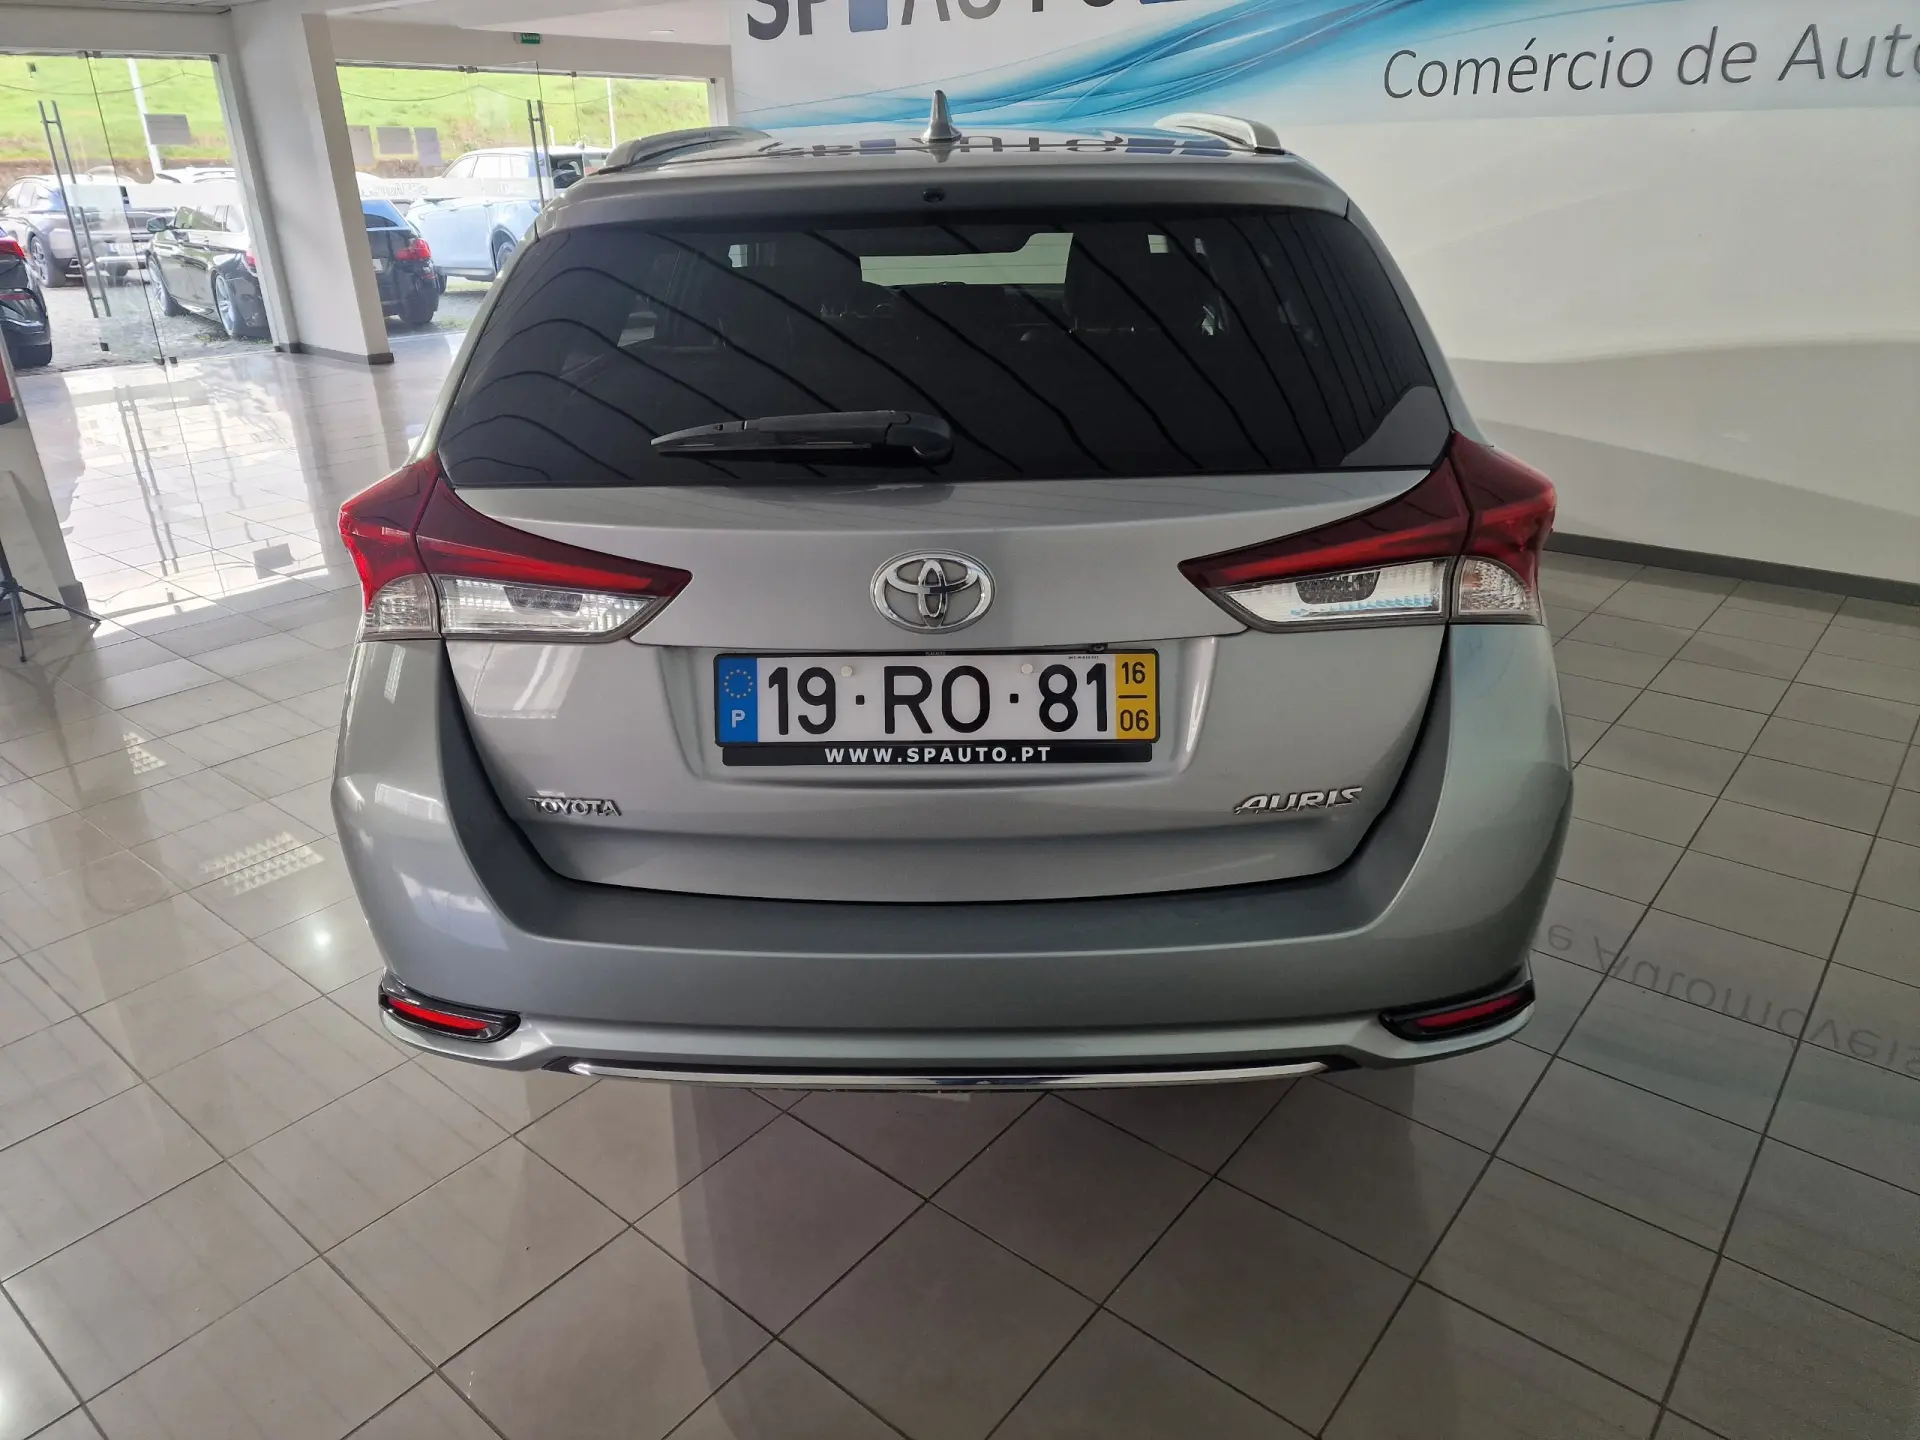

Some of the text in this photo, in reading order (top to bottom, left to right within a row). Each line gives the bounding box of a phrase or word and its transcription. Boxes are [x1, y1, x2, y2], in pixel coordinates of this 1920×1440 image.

[1383, 23, 1920, 99] Comércio de Aut
[1121, 661, 1146, 685] 16
[731, 710, 745, 728] P
[1120, 709, 1149, 732] 06
[824, 747, 1051, 763] WWW.SPAUTO.PT
[528, 795, 622, 816] TOYOTA
[1233, 786, 1363, 815] AURIS
